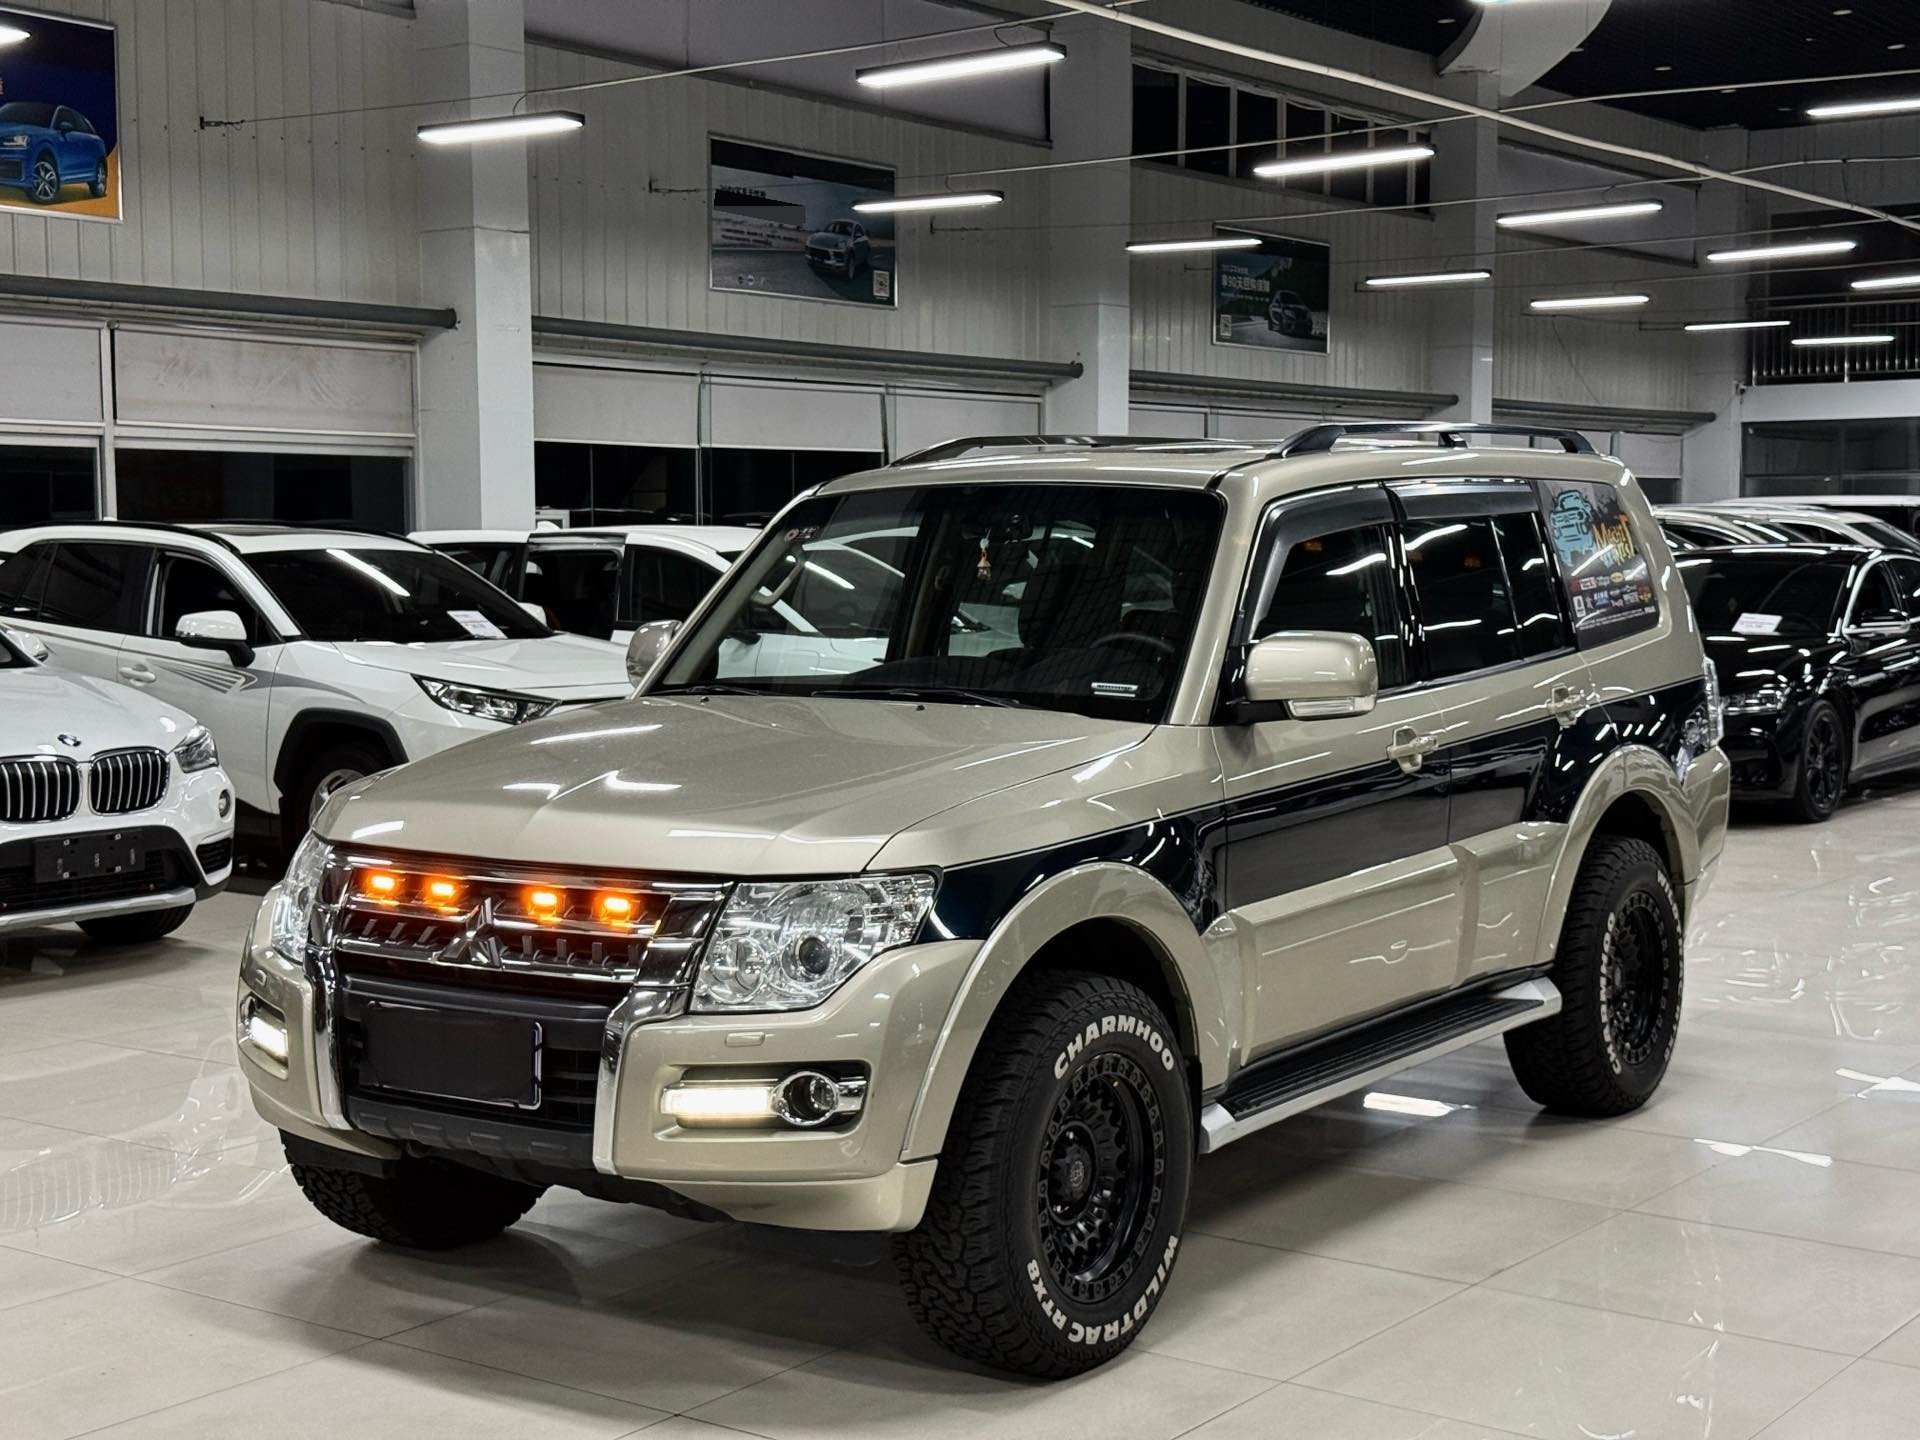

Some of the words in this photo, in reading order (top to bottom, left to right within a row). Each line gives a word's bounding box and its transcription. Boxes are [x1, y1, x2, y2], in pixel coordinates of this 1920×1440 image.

[1599, 911, 1622, 1075] CHARMHOO
[1054, 1014, 1174, 1080] CHARMHOO
[1027, 1259, 1067, 1330] RTX8
[1067, 1235, 1179, 1345] WILDTRAC
